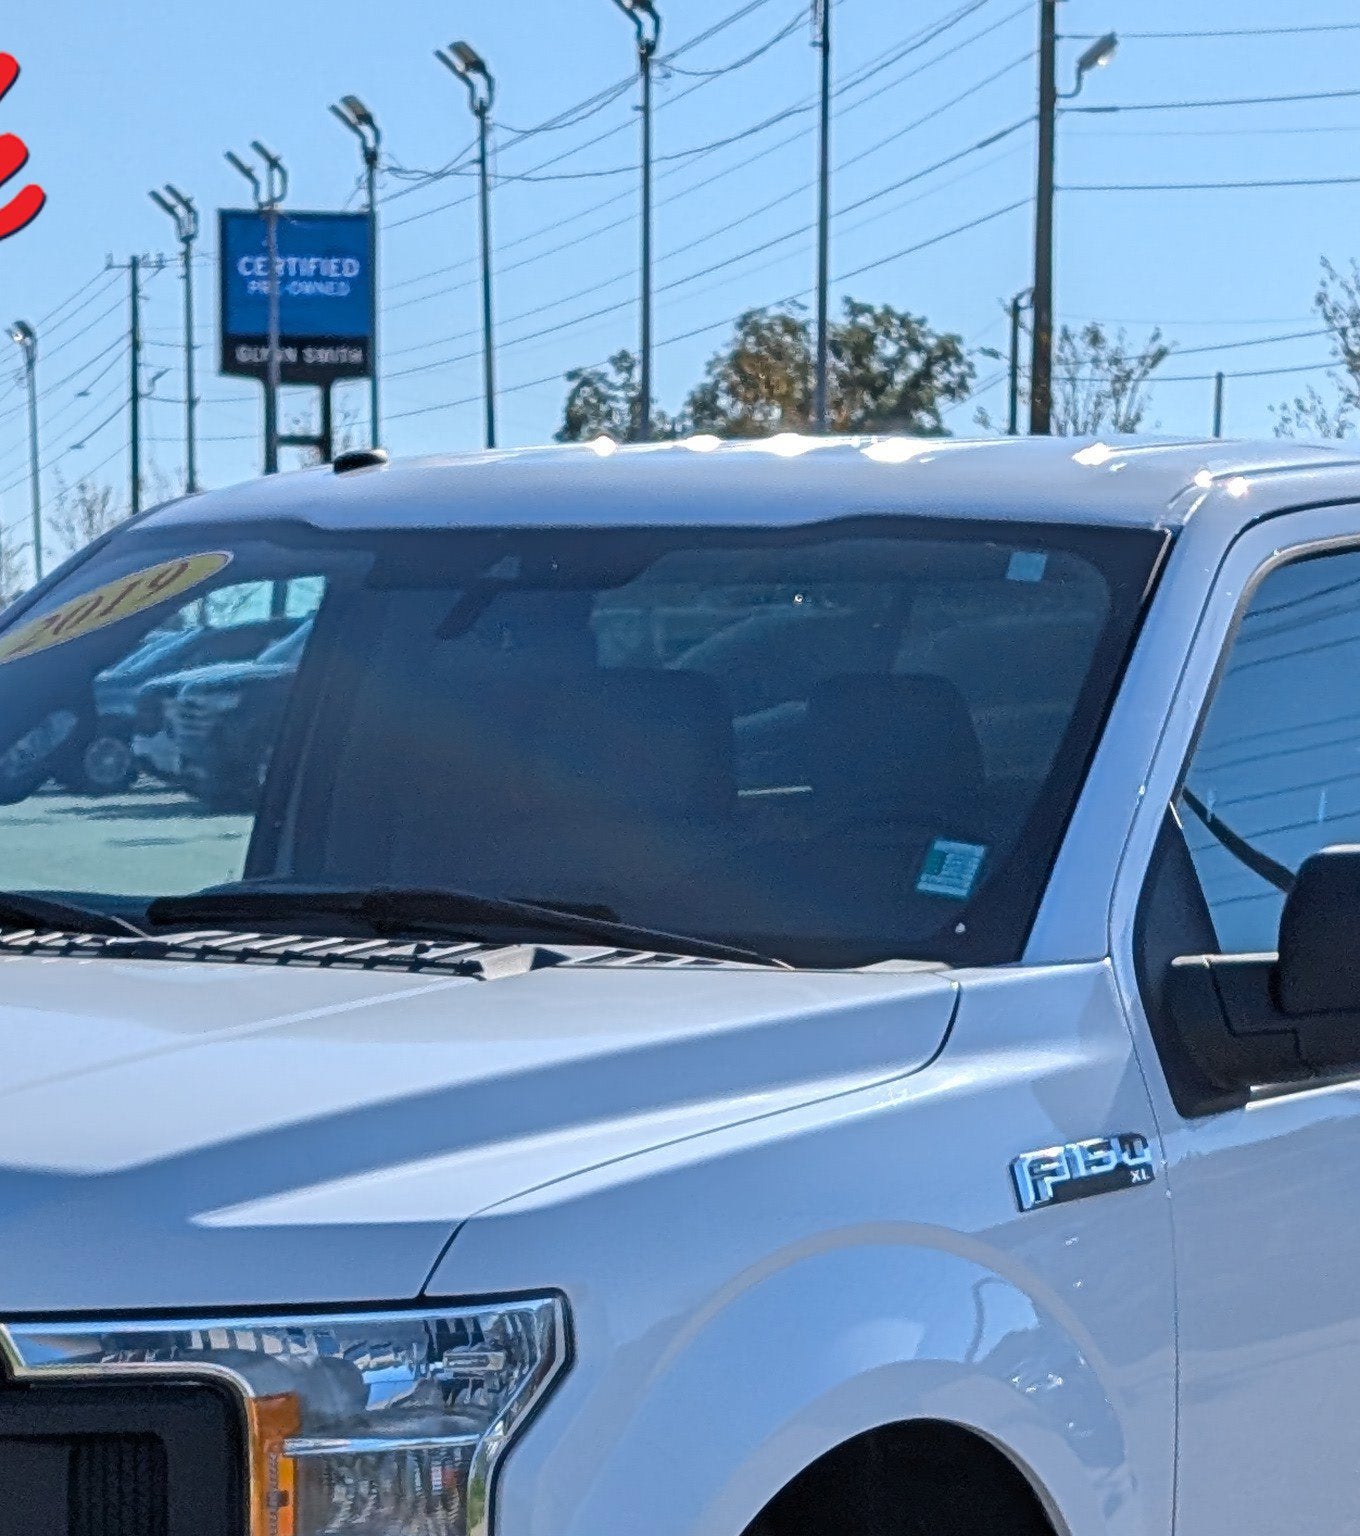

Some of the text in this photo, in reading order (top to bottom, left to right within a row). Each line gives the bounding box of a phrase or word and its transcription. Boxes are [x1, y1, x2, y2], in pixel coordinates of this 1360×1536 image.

[246, 280, 351, 296] PR-OWNED
[6, 562, 190, 657] 2019
[1129, 1168, 1151, 1184] XL
